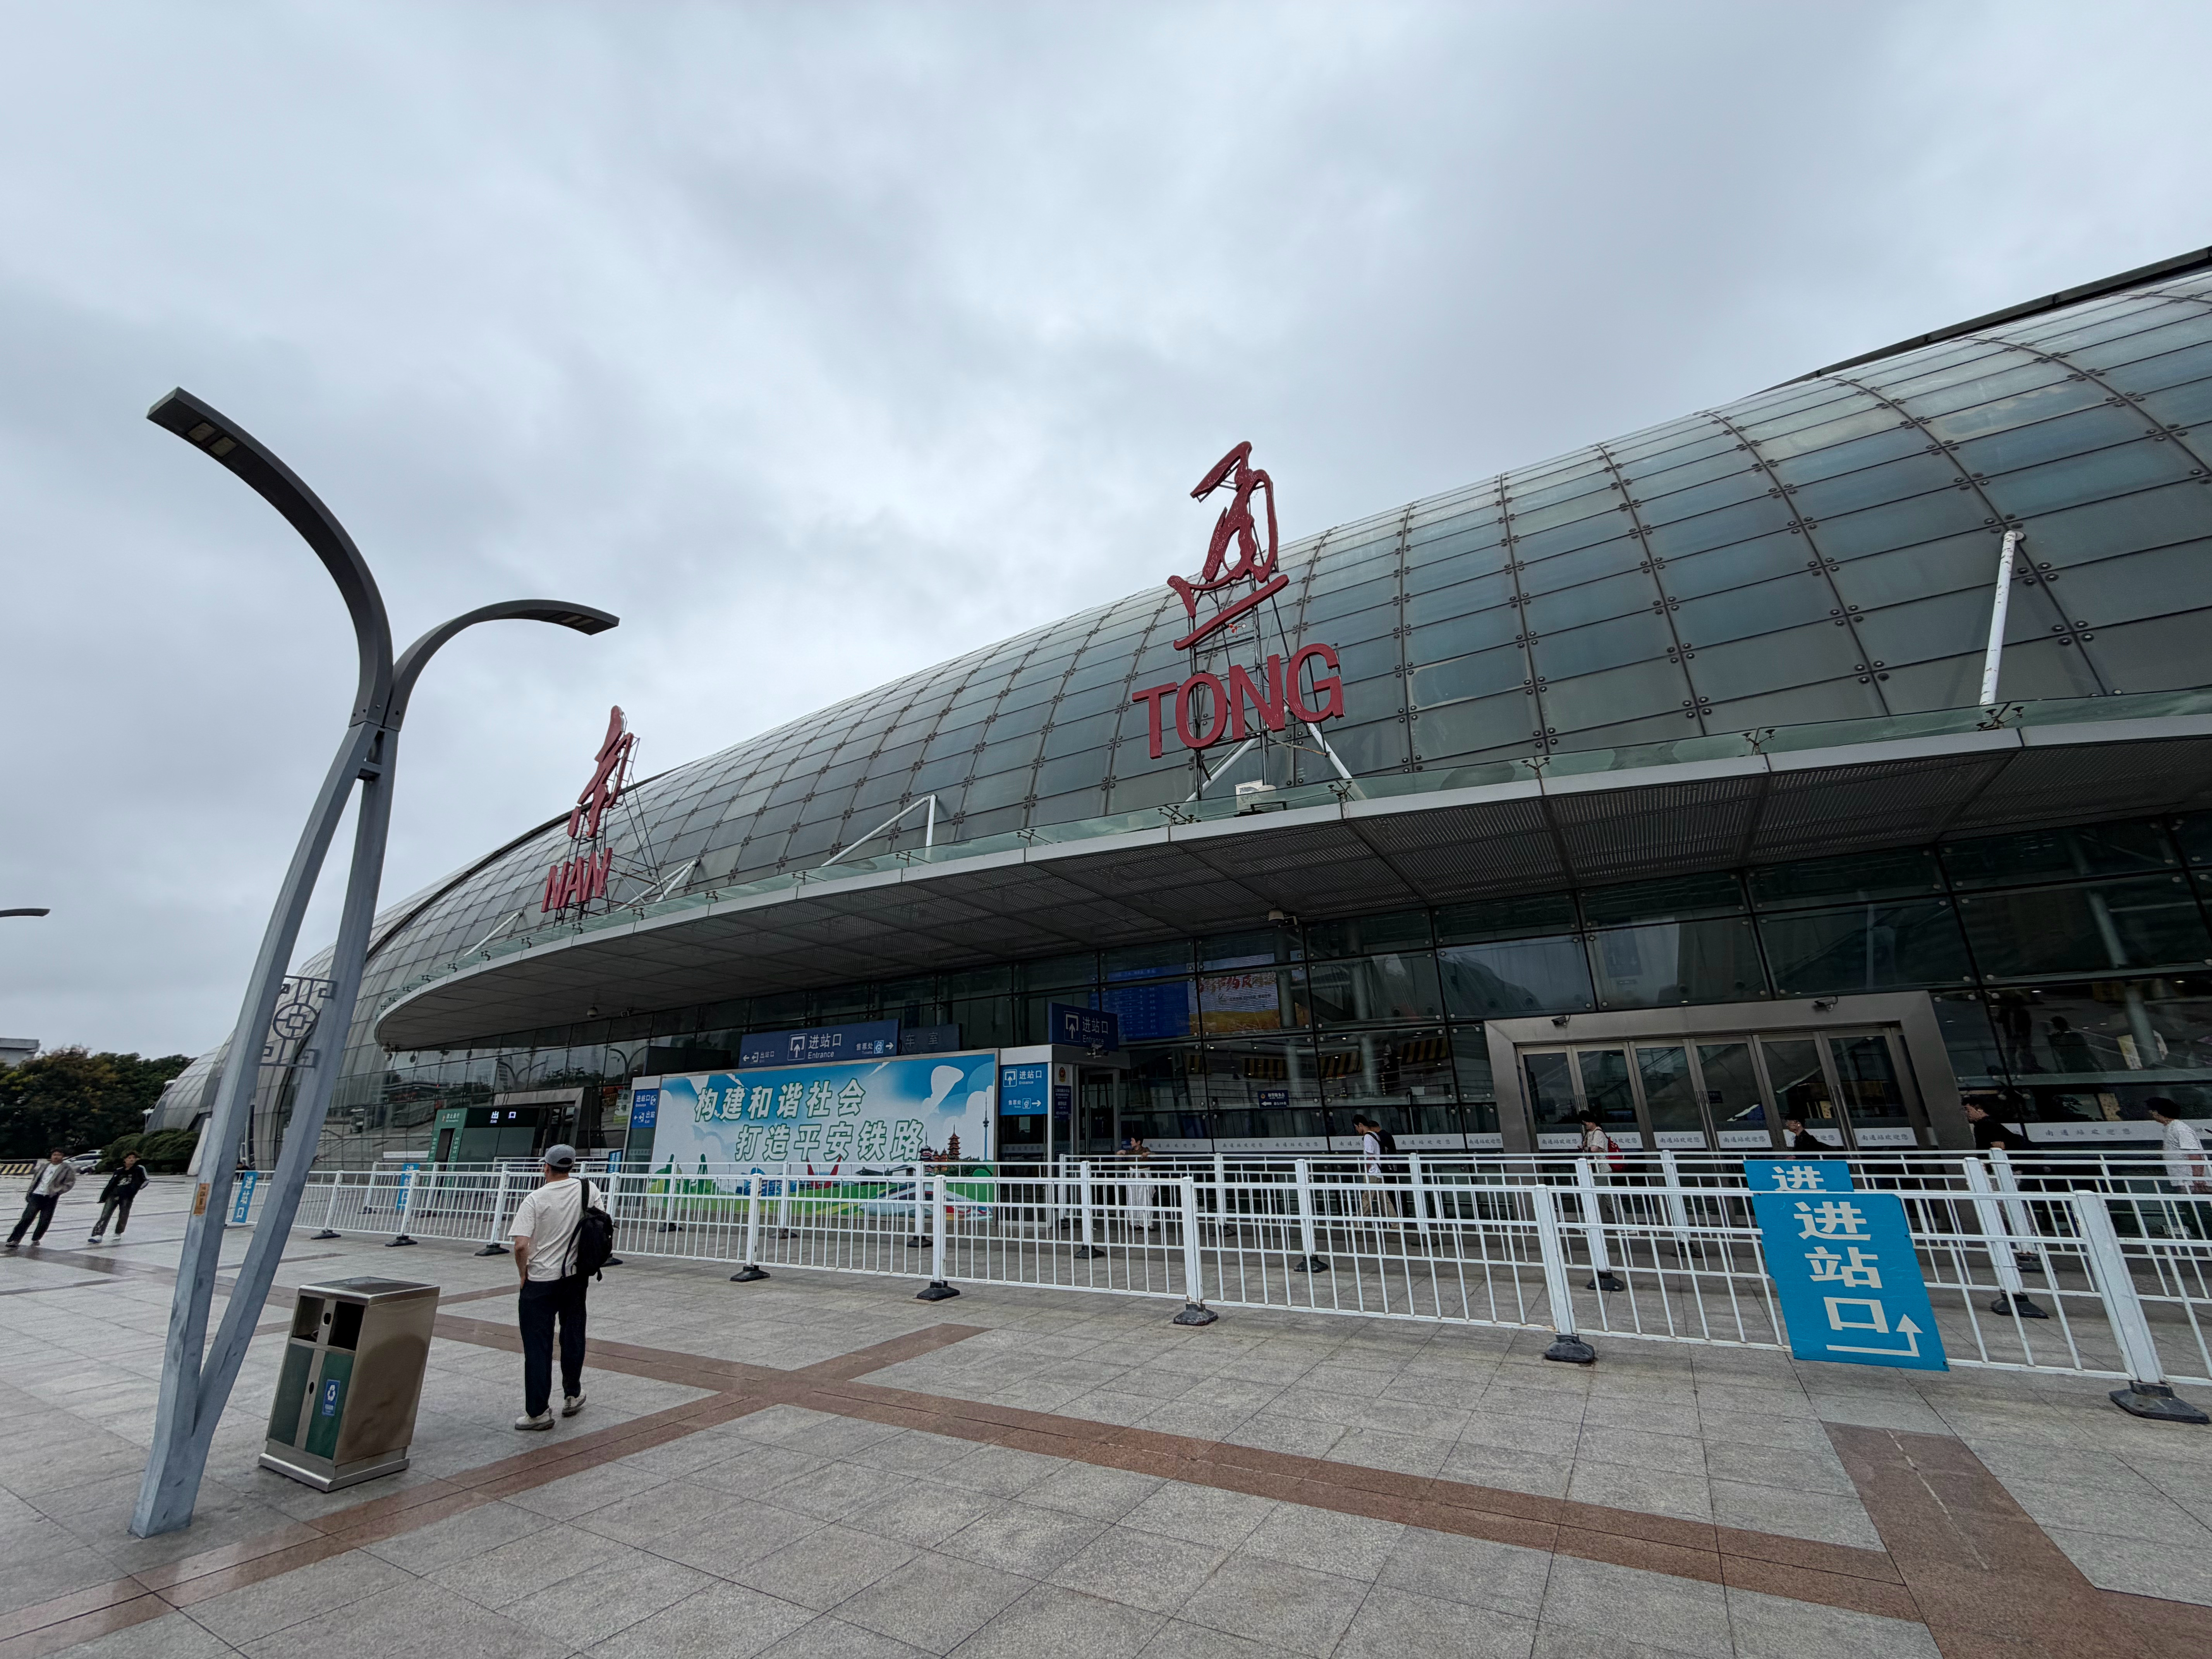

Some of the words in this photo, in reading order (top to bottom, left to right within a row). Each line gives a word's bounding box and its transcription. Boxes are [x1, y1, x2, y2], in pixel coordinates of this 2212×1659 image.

[1132, 643, 1345, 759] TONG
[541, 847, 613, 914] NAN
[1082, 1015, 1109, 1035] 进站口
[808, 1032, 842, 1049] 进站口
[1082, 1035, 1104, 1045] Entrance
[808, 1051, 835, 1060] Entrance
[1019, 1070, 1042, 1080] 进站口
[694, 1077, 866, 1123] 构建和谐社会
[735, 1118, 924, 1162] 打造平安铁路
[1771, 1166, 1827, 1192] 进
[1793, 1201, 1889, 1334] 进站口
